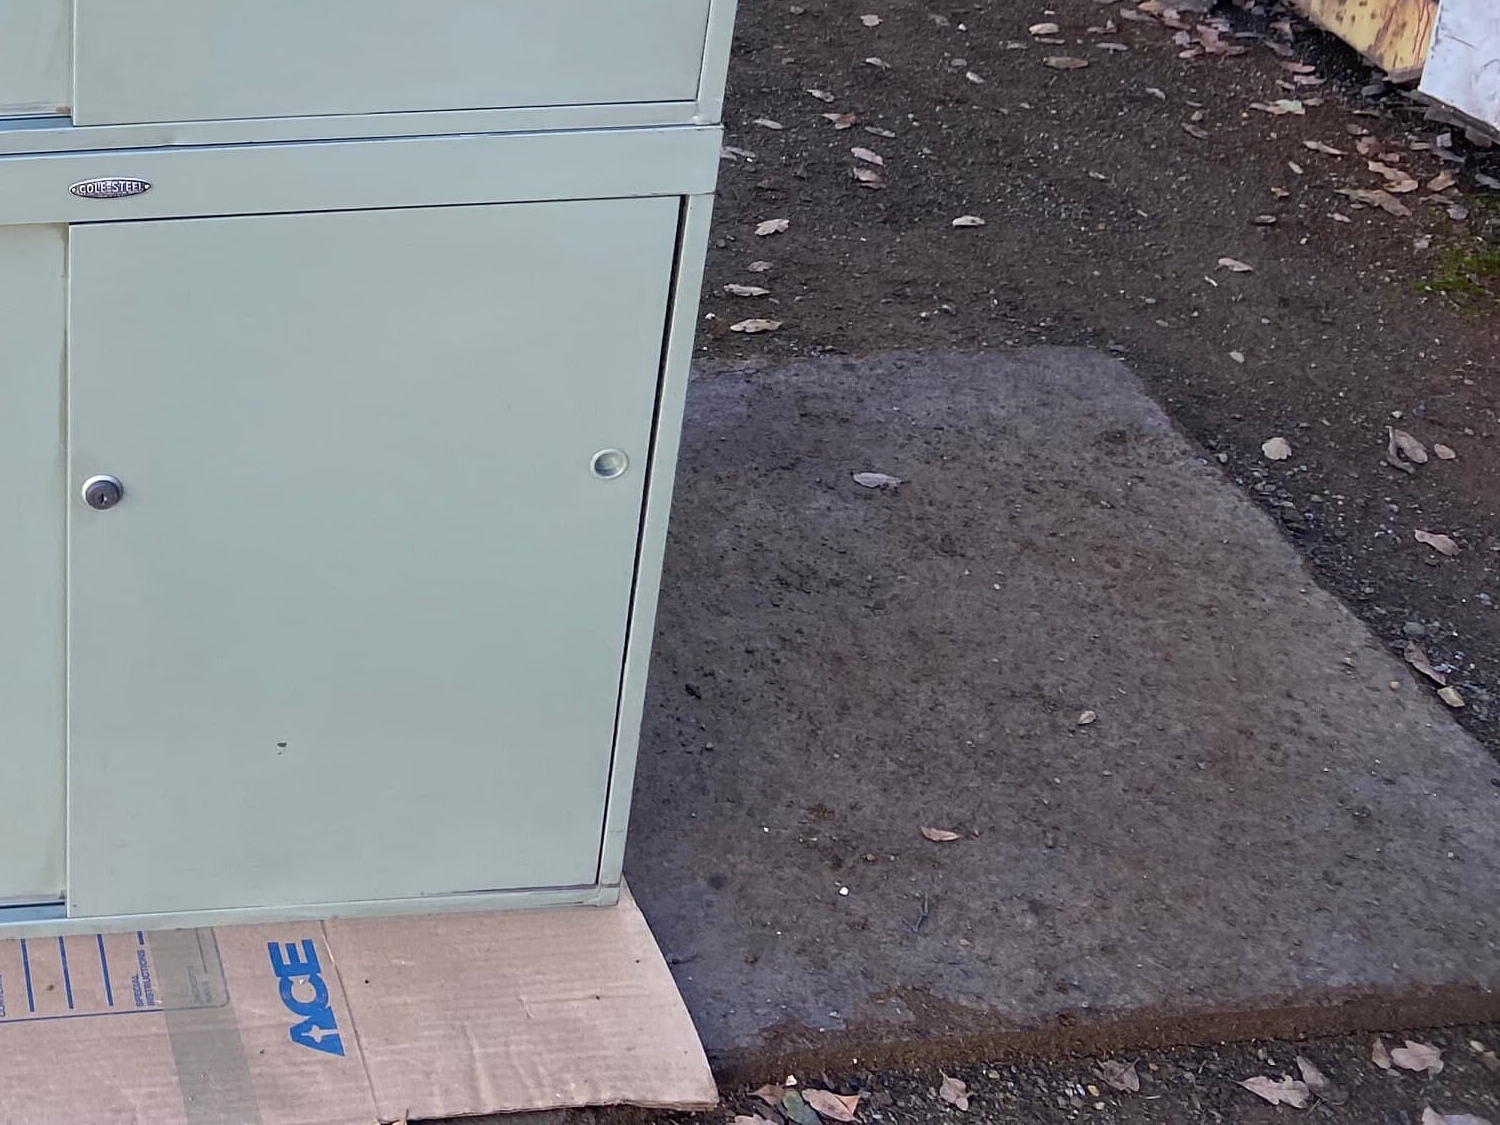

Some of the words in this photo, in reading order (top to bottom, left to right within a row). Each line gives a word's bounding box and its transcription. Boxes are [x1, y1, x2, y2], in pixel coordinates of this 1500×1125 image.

[131, 973, 144, 1008] SPECIAL
[137, 950, 155, 1007] INSTRUCTIONS
[267, 938, 346, 1057] ACE
